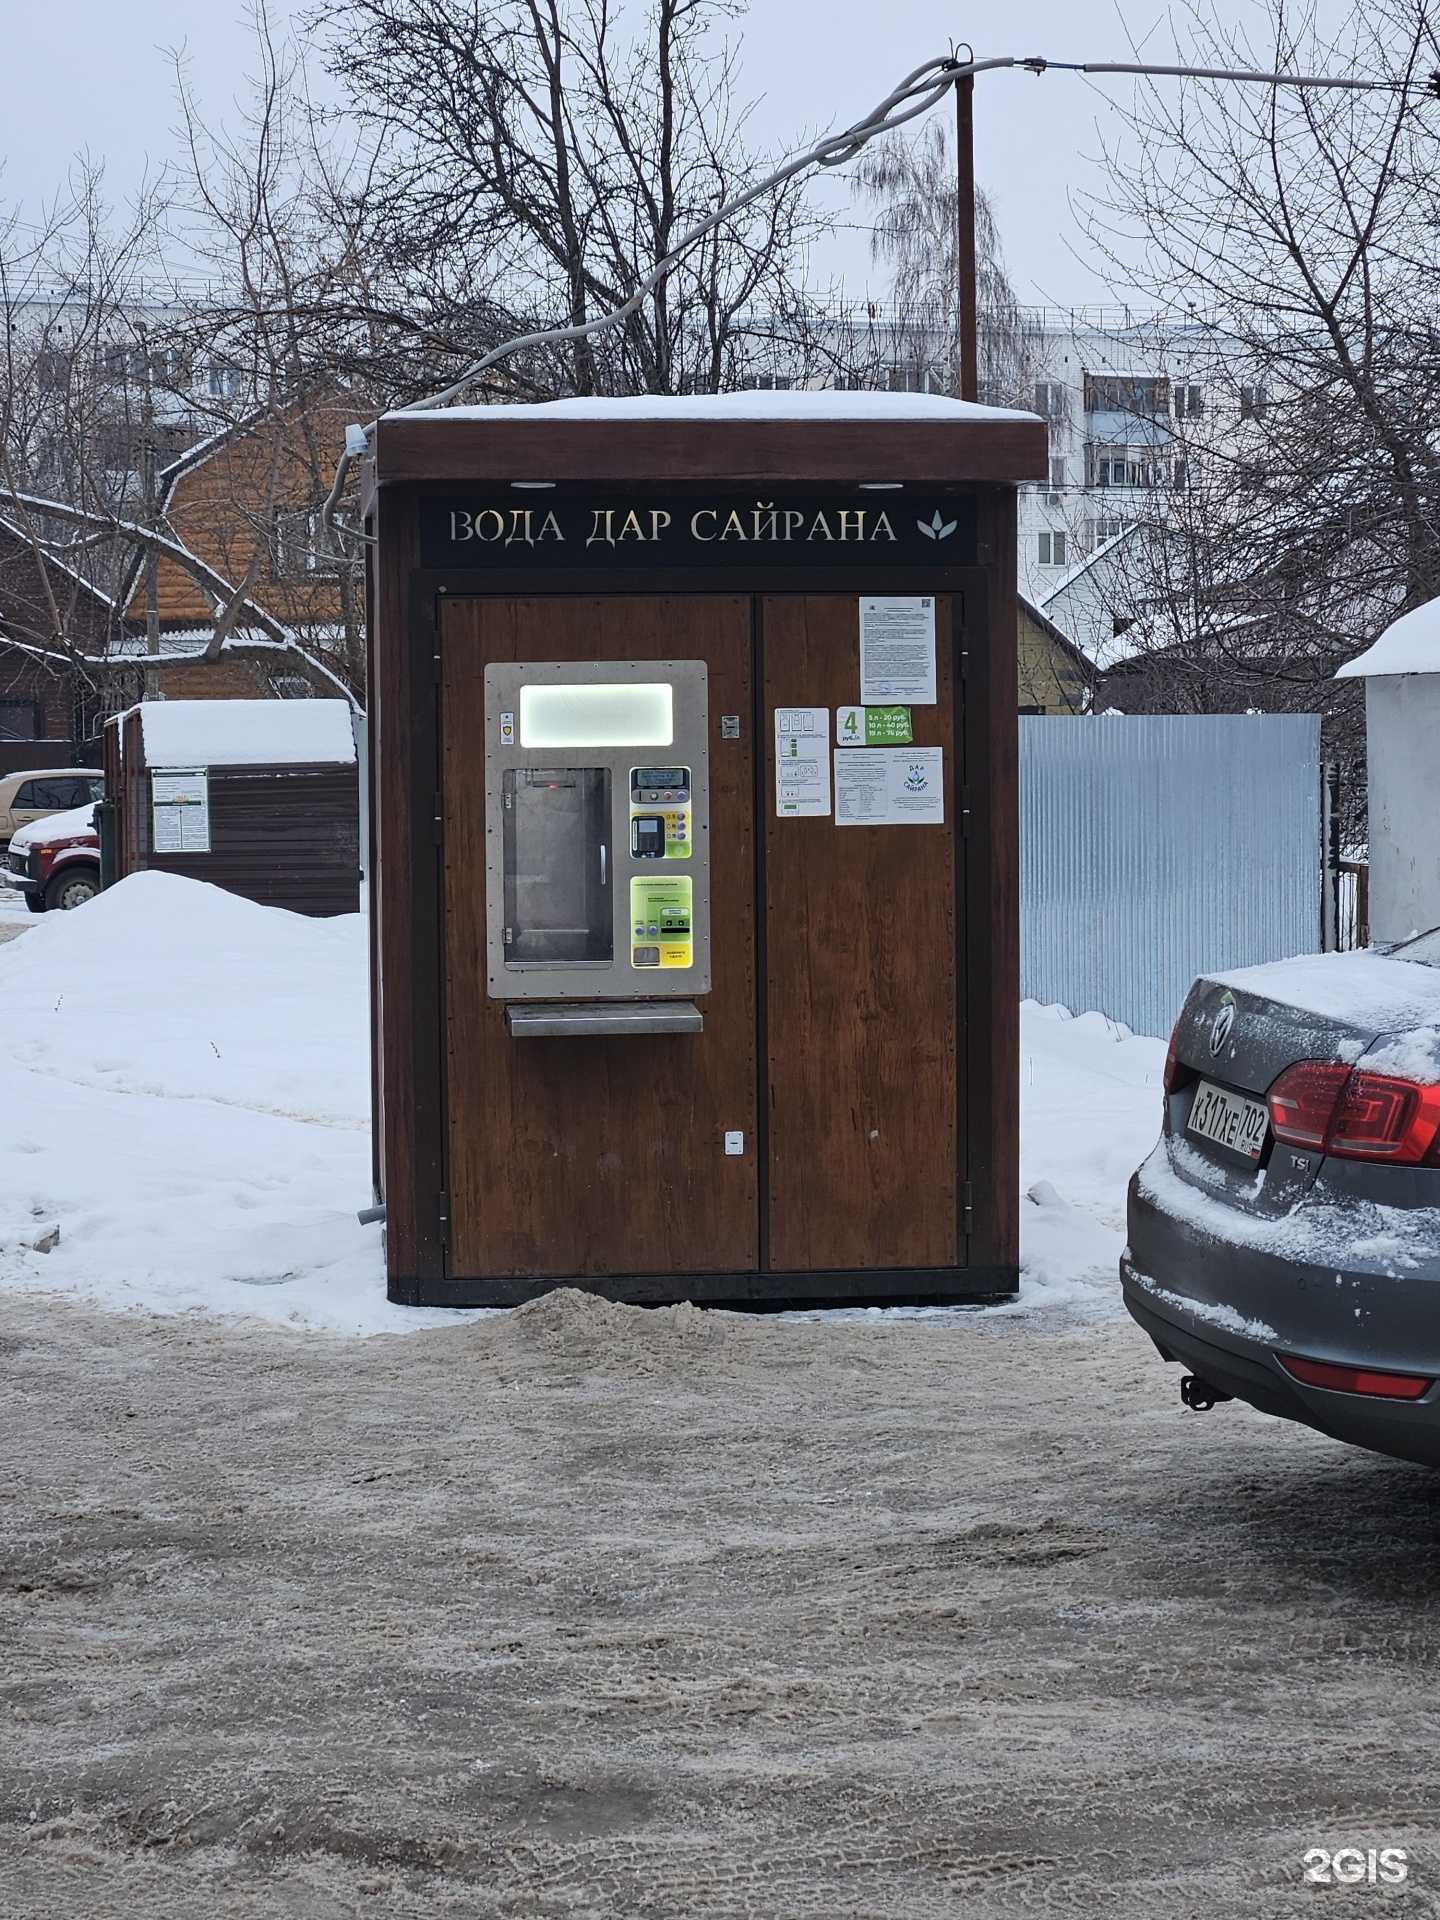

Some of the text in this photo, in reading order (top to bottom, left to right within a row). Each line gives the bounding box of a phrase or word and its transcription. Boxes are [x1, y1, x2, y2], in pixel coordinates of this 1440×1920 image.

[450, 501, 898, 550] ВОДА ДАР САЙРАНА
[844, 711, 858, 734] 4
[1239, 1104, 1265, 1143] 702
[1290, 1154, 1310, 1172] TSI
